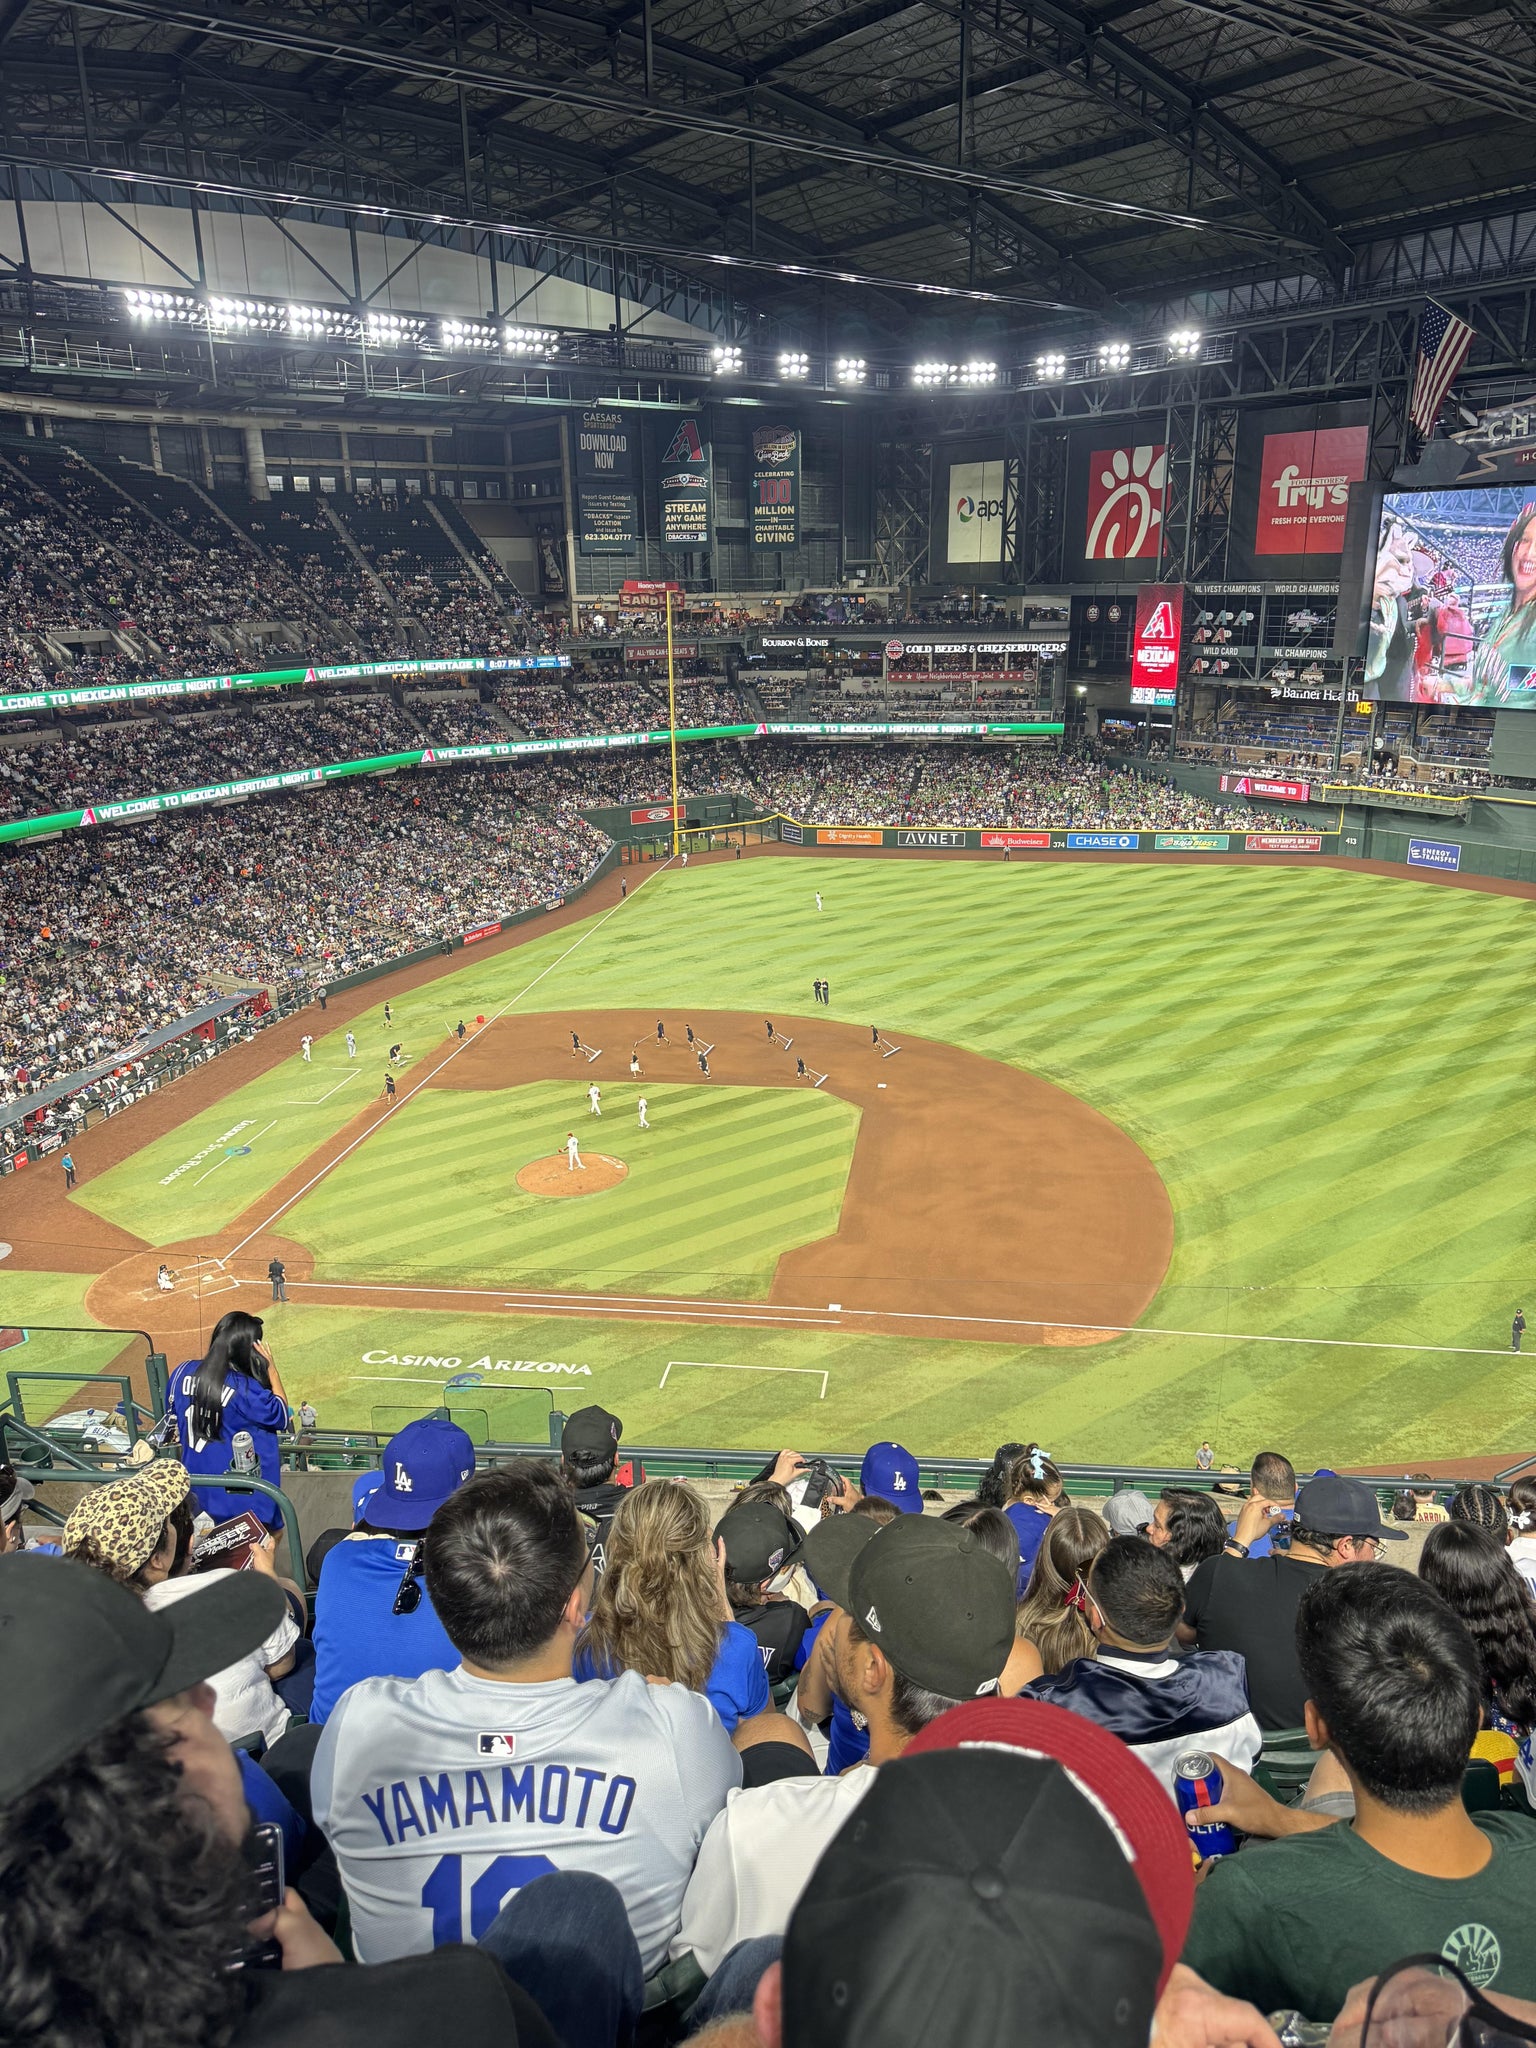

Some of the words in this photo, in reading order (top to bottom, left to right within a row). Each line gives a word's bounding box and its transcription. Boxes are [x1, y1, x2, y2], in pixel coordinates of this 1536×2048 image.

[583, 412, 622, 424] CAESARS
[580, 433, 627, 452] DOWNLOAD
[594, 452, 615, 469] NOW
[1291, 478, 1312, 486] FOOD
[1314, 476, 1345, 485] STORES
[752, 479, 792, 505] $100
[1271, 465, 1349, 510] fry's
[664, 503, 707, 513] STREAM
[754, 505, 795, 515] MILLION
[665, 514, 682, 522] ANY
[683, 514, 707, 522] GAME
[770, 516, 779, 524] IN
[1271, 516, 1292, 525] FRESH
[1293, 515, 1307, 524] FOR
[1309, 514, 1345, 524] EVERYONE
[665, 523, 707, 531] ANYWHERE
[754, 524, 795, 532] CHARITABLE
[584, 533, 632, 541] 623.304.0777
[755, 532, 795, 543] GIVING
[637, 582, 666, 590] Honeywell
[1194, 584, 1202, 593] NL
[1203, 584, 1222, 593] WEST
[1223, 585, 1262, 593] CHAMPIONS
[1274, 584, 1297, 593] WORLD
[1298, 585, 1340, 593] CHAMPIONS
[622, 595, 684, 606] SANDLT
[796, 638, 804, 647] &
[805, 638, 829, 647] BONES
[636, 648, 673, 656] ALL-YOU-CAN-E
[906, 645, 932, 653] COLD
[935, 645, 967, 653] BEERS
[977, 643, 1067, 653] CHEESEBURGERS
[1203, 647, 1220, 656] WILD
[1220, 647, 1239, 656] CARD
[1137, 649, 1176, 664] MEXICAN
[1273, 649, 1284, 657] NL
[1284, 650, 1328, 659] CHAMPIONS
[489, 660, 507, 669] 8:07
[508, 659, 521, 668] PM
[317, 667, 361, 679] WELCOME
[361, 666, 374, 675] TO
[375, 662, 418, 674] MEXICAN
[420, 660, 474, 671] HERITAGE
[915, 673, 929, 681] Your
[929, 672, 962, 680] Neighborhood
[962, 672, 981, 681] Burger
[982, 672, 994, 680] Joint
[51, 692, 68, 705] TO
[71, 688, 127, 703] MEXICAN
[129, 682, 184, 697] HERITAGE
[186, 679, 219, 692] NIGHT
[1282, 687, 1320, 700] Banner
[1323, 689, 1359, 702] Heath
[770, 725, 821, 734] WELCOME
[824, 725, 838, 733] TO
[840, 725, 886, 734] MEXICAN
[889, 725, 939, 734] HERITAGE
[941, 725, 974, 734] NIGHT
[437, 747, 493, 759] WELCOME
[496, 746, 510, 755] TO
[511, 742, 557, 753] MEXICAN
[559, 739, 607, 749] HERITAGE
[608, 735, 637, 746] NIGHT
[1254, 783, 1287, 794] WELCOME
[1287, 786, 1297, 795] TO
[98, 799, 161, 819] WELCOME
[163, 795, 179, 807] TO
[180, 784, 230, 805] MEXICAN
[231, 777, 281, 796] HERITAGE
[281, 771, 310, 786] NIGHT
[905, 833, 960, 845] AVNET
[1007, 837, 1044, 845] Budweiser
[1075, 836, 1117, 846] CHASE
[1261, 837, 1296, 845] MEMBERSHIPS
[1345, 837, 1357, 845] 413
[1052, 841, 1065, 849] 374
[1422, 847, 1451, 857] ENERGY
[1422, 853, 1457, 864] TRANSFER
[361, 1350, 463, 1369] CASINO
[467, 1355, 593, 1376] ARIZONA
[92, 1426, 113, 1438] BETTS
[394, 1461, 413, 1492] LA
[893, 1471, 907, 1491] LA
[361, 1764, 638, 1847] YAMAMOTO
[1186, 1822, 1226, 1835] ULTR
